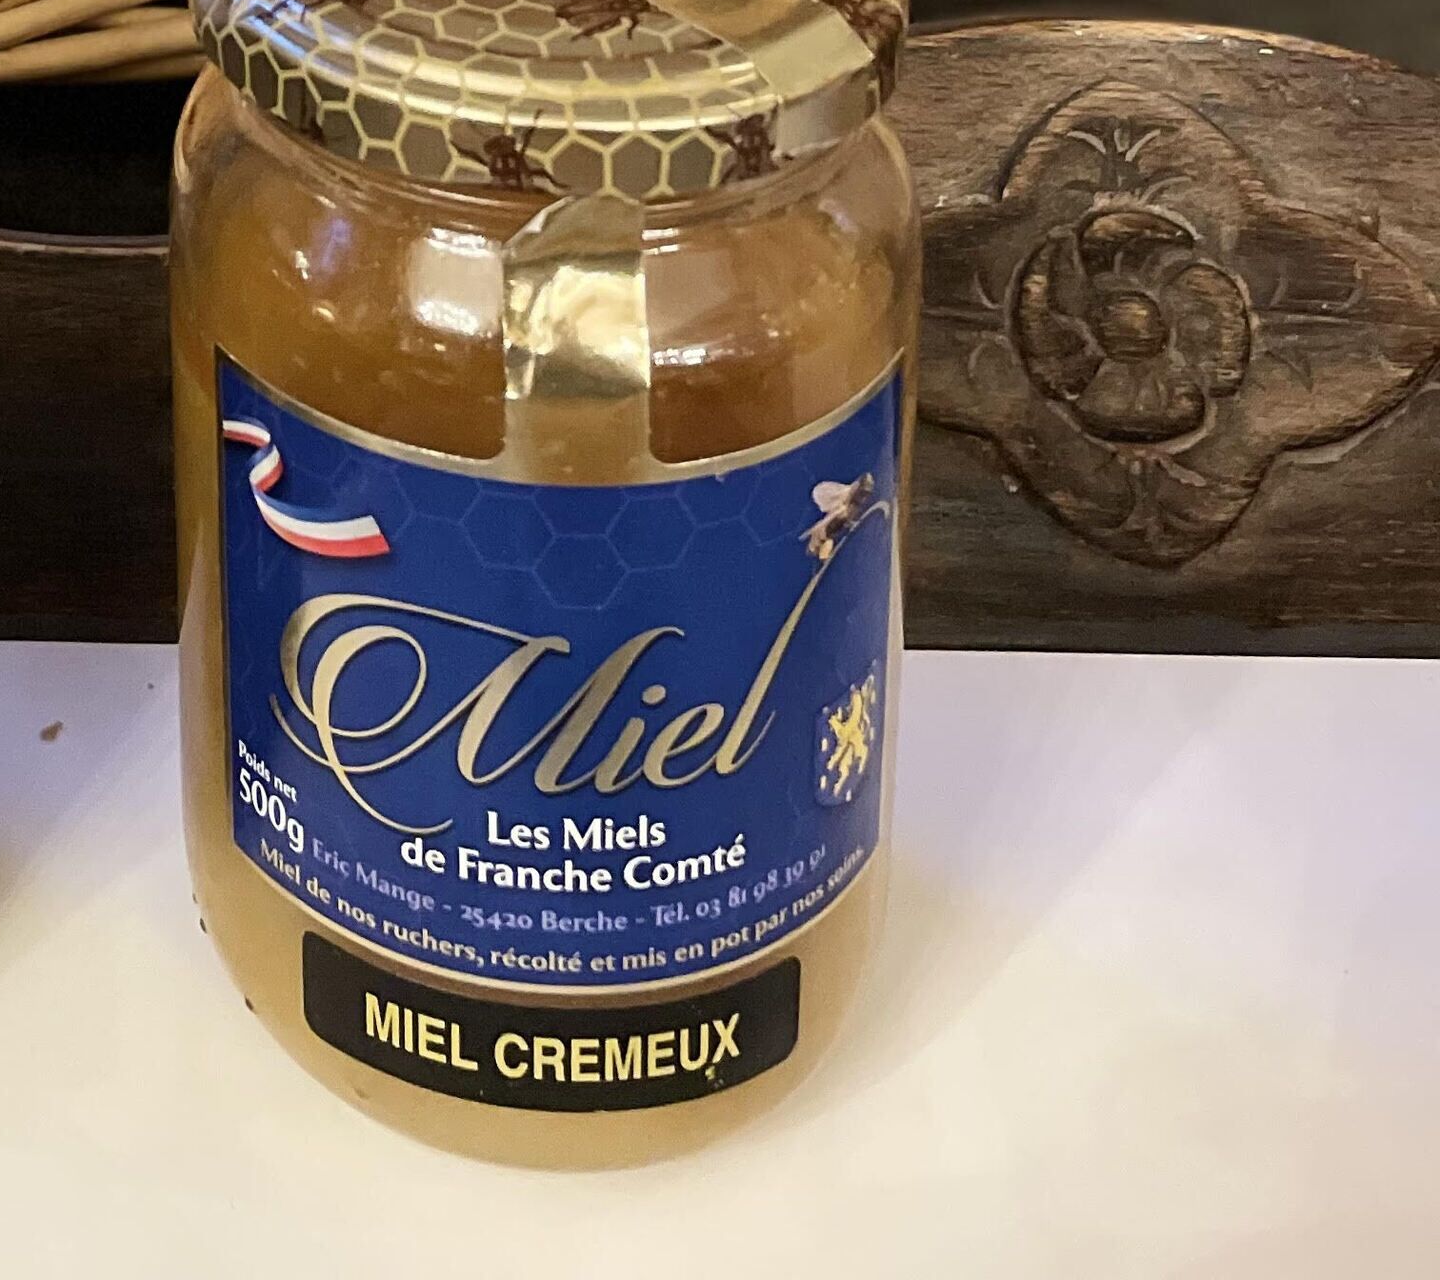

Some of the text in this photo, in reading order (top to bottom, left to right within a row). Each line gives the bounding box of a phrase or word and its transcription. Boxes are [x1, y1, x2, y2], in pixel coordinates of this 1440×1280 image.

[269, 499, 889, 835] Miel
[237, 739, 298, 804] Poids net
[239, 767, 305, 854] 500g
[400, 832, 747, 893] de Franche Comté
[487, 810, 667, 852] Les Miels
[259, 837, 302, 886] Miel
[305, 877, 332, 905] de
[336, 896, 377, 929] nos
[382, 918, 485, 968] ruchers,
[490, 944, 582, 974] récolté
[590, 952, 616, 973] et
[622, 946, 667, 972] mis
[674, 942, 705, 965] en
[710, 926, 750, 959] pot
[754, 905, 789, 944] par
[792, 883, 826, 917] nos
[311, 837, 351, 879] Eric
[355, 862, 436, 911] Mange
[460, 903, 533, 932] 25420
[541, 909, 629, 934] Berche
[650, 904, 691, 928] Tél.
[695, 898, 723, 920] 03
[727, 885, 748, 910] 81
[753, 868, 779, 903] 98
[364, 991, 742, 1083] MIEL CREMEUX
